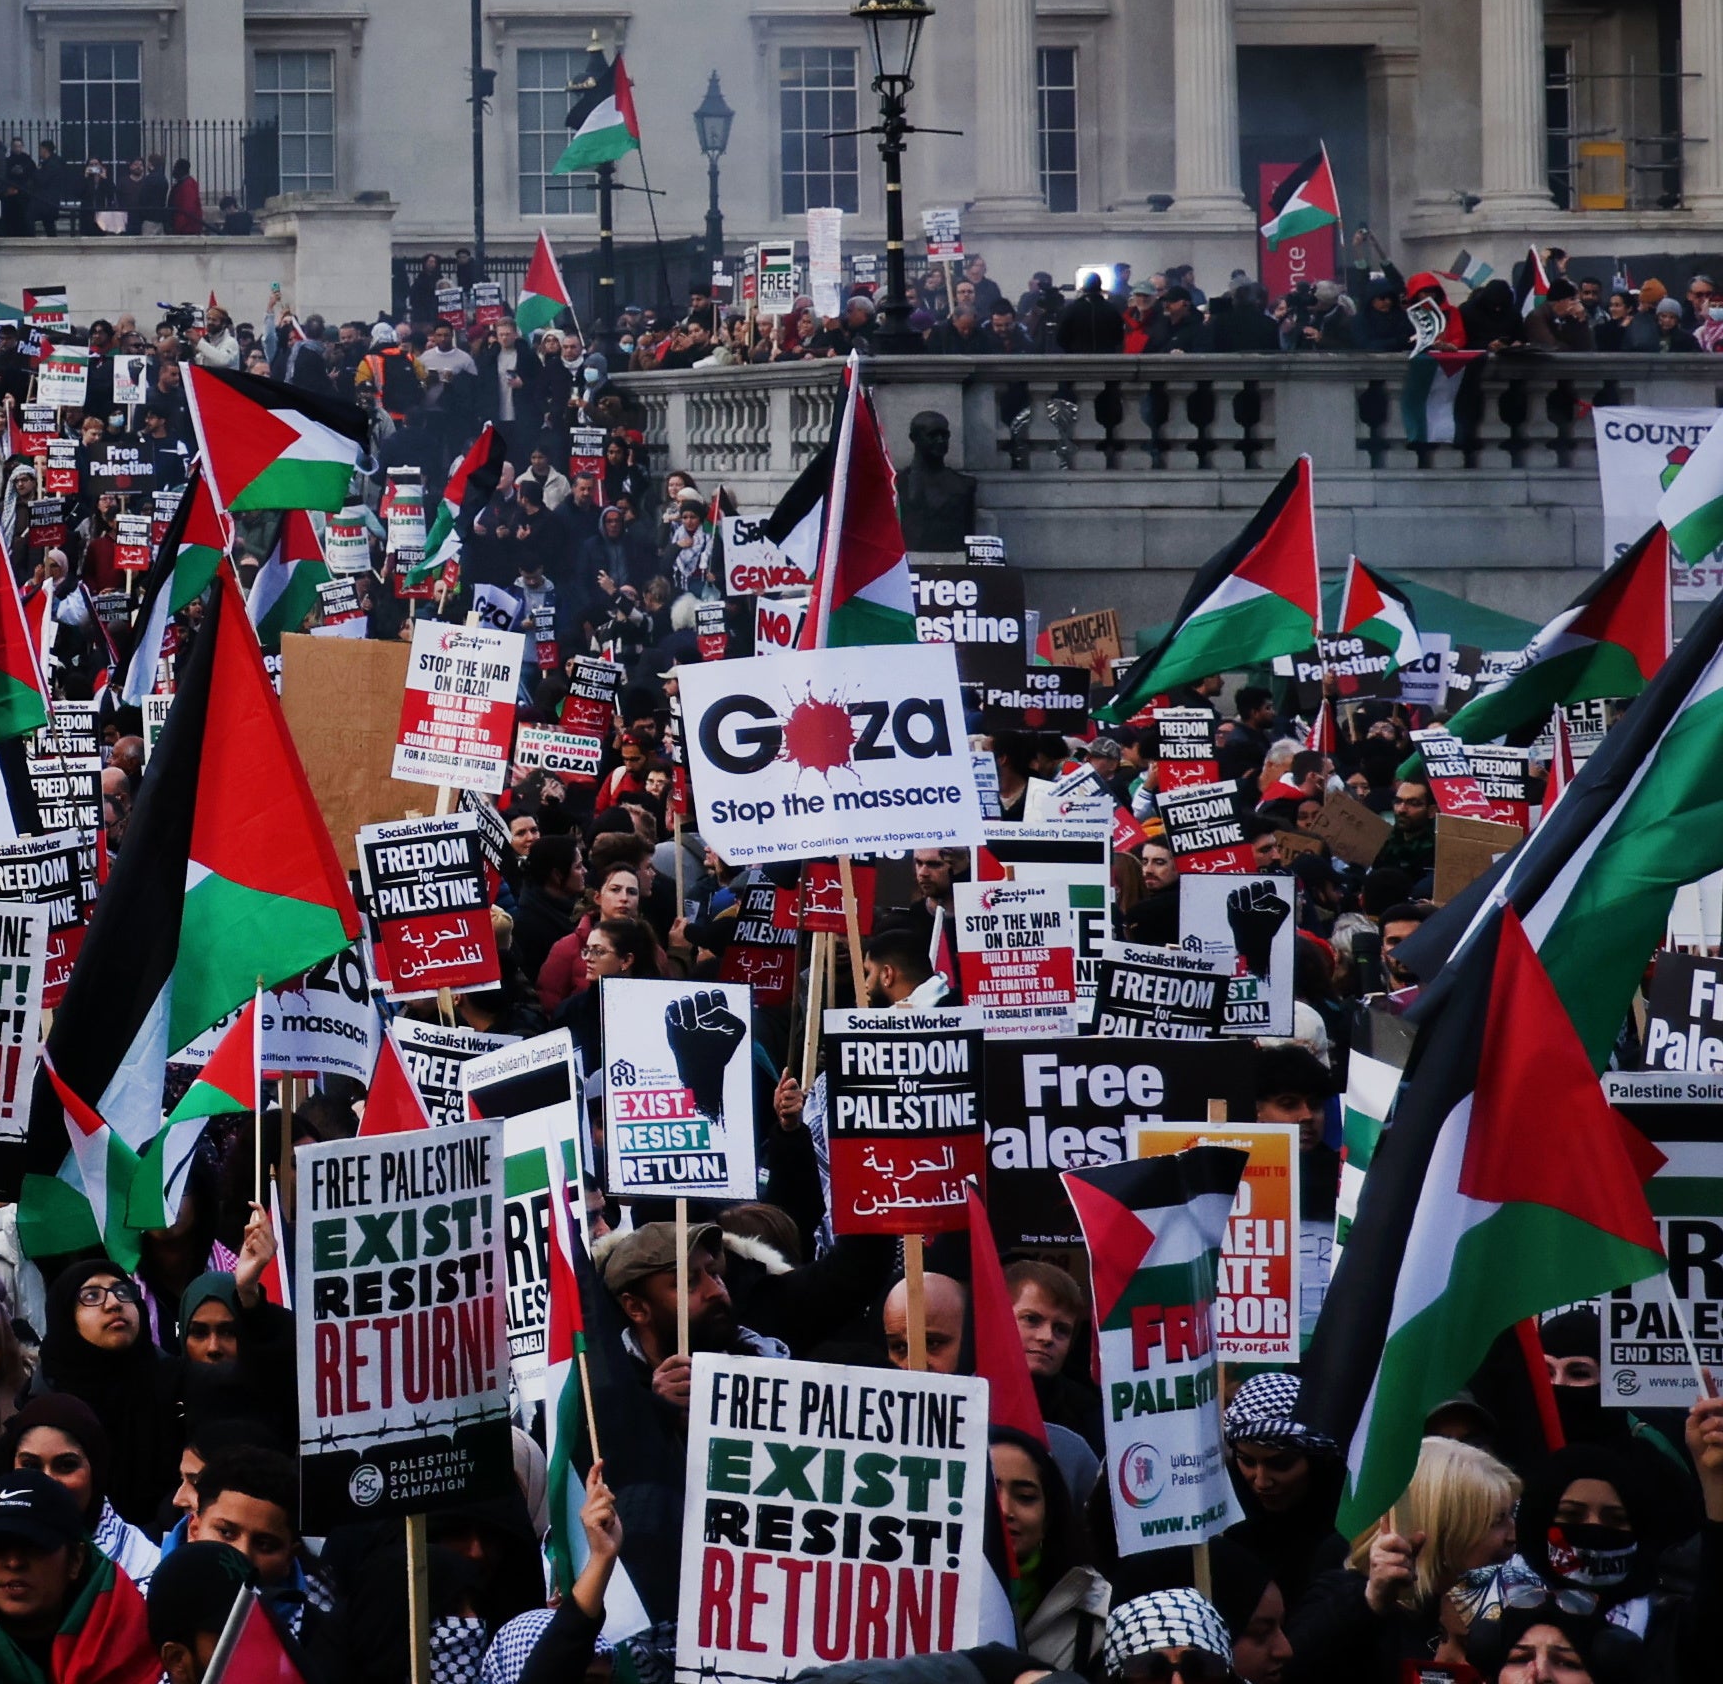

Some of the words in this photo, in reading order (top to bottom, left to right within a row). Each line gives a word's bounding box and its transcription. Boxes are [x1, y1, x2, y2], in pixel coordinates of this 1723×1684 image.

[760, 274, 791, 288] FREE
[106, 445, 138, 460] Free
[90, 460, 153, 476] Palestine
[758, 609, 791, 643] NO
[1053, 612, 1111, 649] ENOUGH!
[420, 654, 453, 672] STOP
[456, 660, 479, 676] THE
[482, 664, 510, 682] WAR
[576, 667, 616, 682] FREEDOM
[434, 676, 452, 690] ON
[455, 679, 490, 697] GAZA!
[570, 684, 613, 701] PALESTINE
[987, 690, 1084, 709] Palestine
[428, 694, 453, 706] BUILD
[456, 698, 463, 707] A
[465, 698, 491, 712] MASS
[417, 719, 476, 740] ALTERNATIVE
[478, 730, 489, 741] TO
[523, 731, 552, 742] STOP
[555, 734, 598, 747] KILLING
[699, 695, 952, 775] Gza
[1159, 722, 1208, 737] FREEDOM
[404, 733, 434, 749] SUNAK
[436, 737, 456, 752] AND
[458, 740, 503, 757] STARMER
[521, 741, 540, 751] THE
[543, 744, 599, 758] CHILDREN
[1159, 743, 1212, 759] PALESTINE
[521, 752, 541, 766] IN
[545, 755, 595, 773] GAZA
[711, 800, 775, 825] Stop
[782, 793, 823, 817] the
[834, 783, 961, 810] massacre
[841, 1039, 969, 1076] FREEDOM
[897, 1076, 920, 1095] for
[615, 1092, 694, 1120] EXIST.
[837, 1093, 976, 1129] PALESTINE
[619, 1124, 710, 1150] RESIST.
[312, 1155, 371, 1210] FREE
[380, 1136, 491, 1205] PALESTINE
[621, 1156, 727, 1183] RETURN.
[312, 1195, 493, 1272] EXIST!
[314, 1250, 494, 1320] RESIST!
[315, 1296, 497, 1418] RETURN!
[710, 1372, 788, 1433] FREE
[799, 1381, 967, 1450] PALESTINE
[707, 1437, 966, 1516] EXIST!
[704, 1498, 963, 1569] RESIST!
